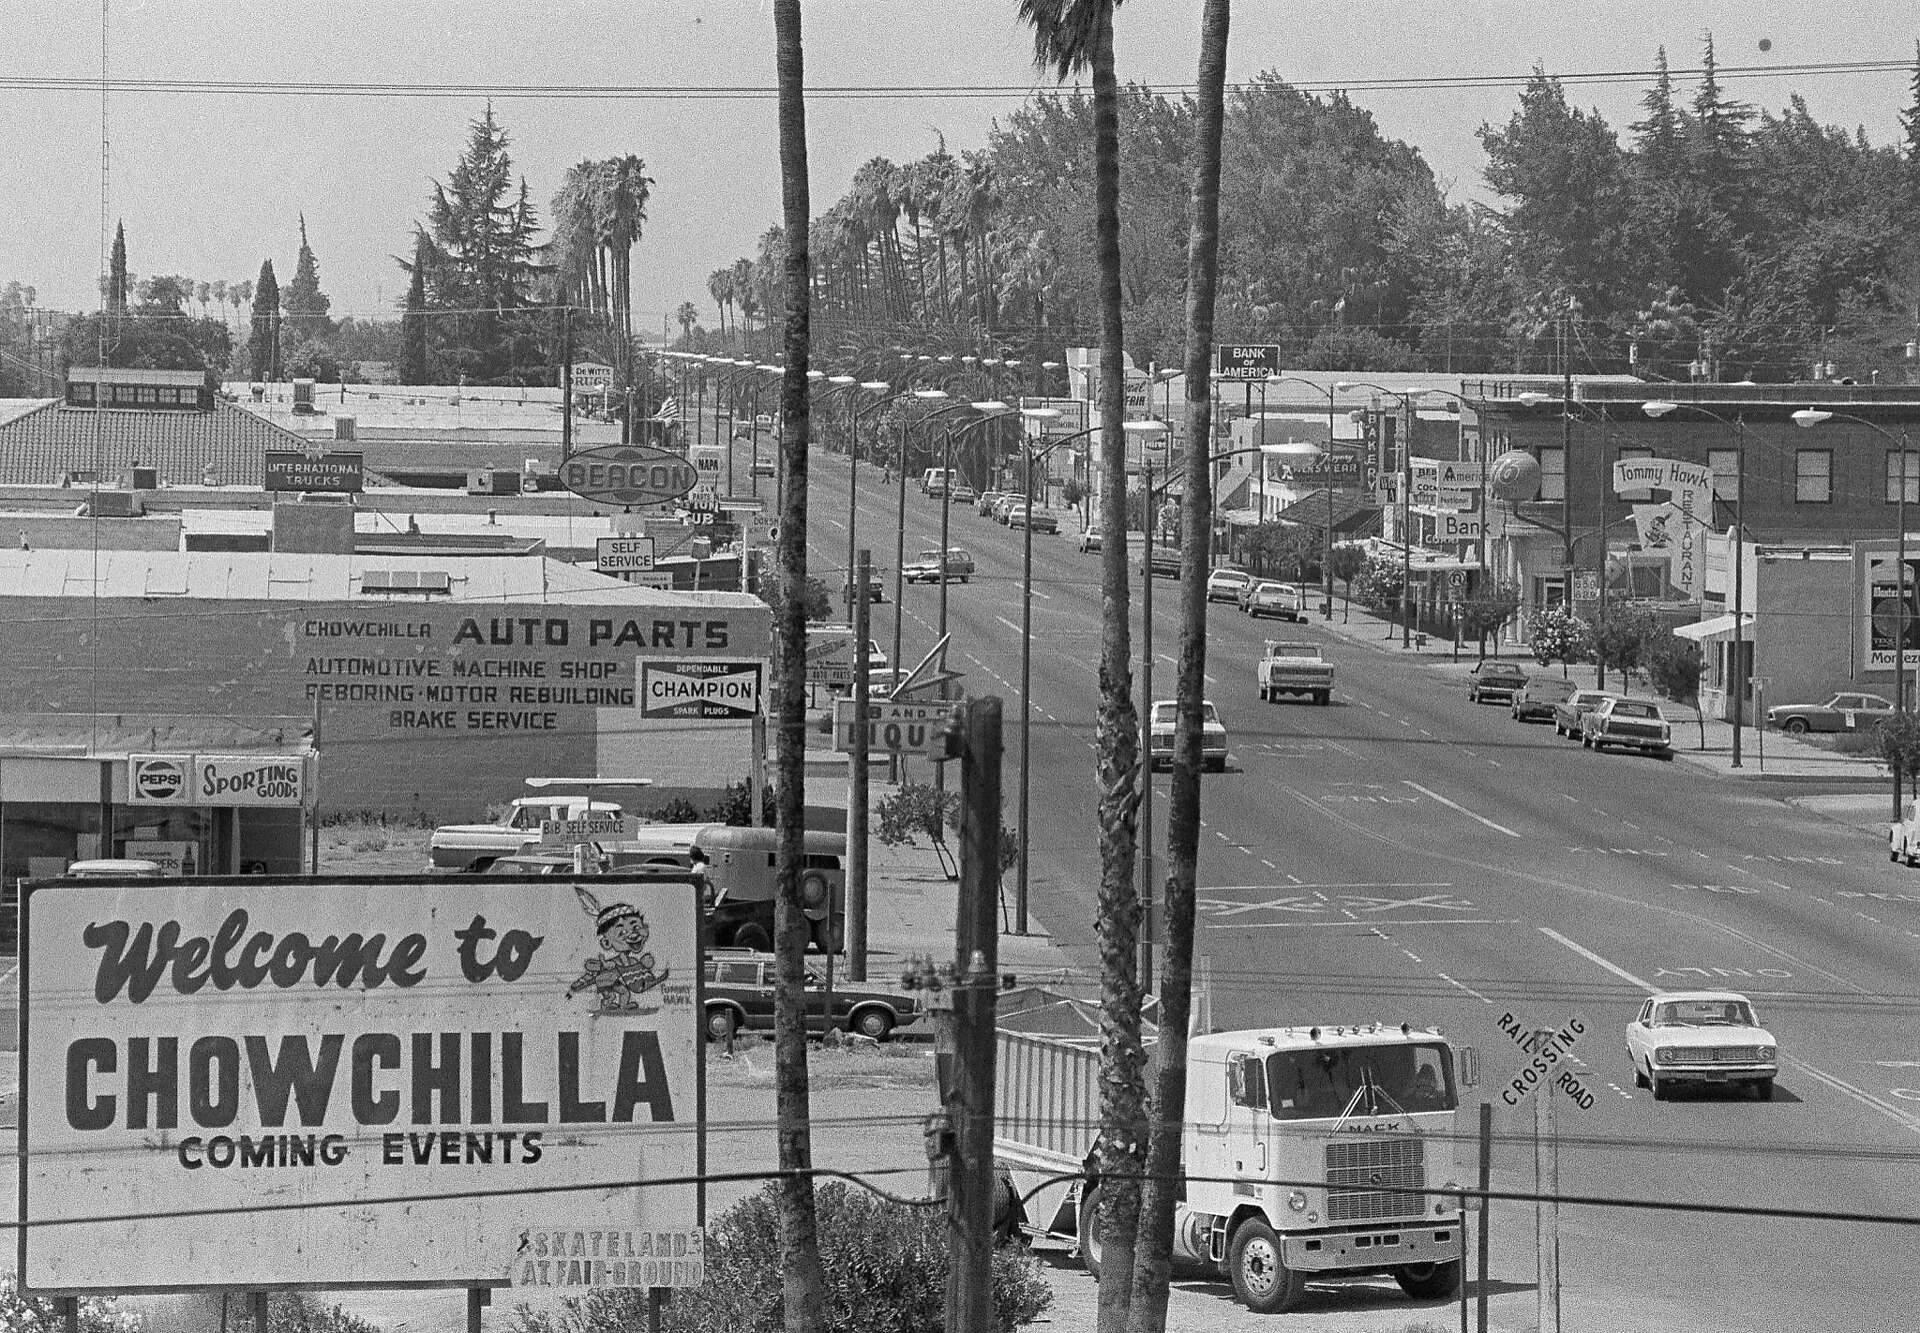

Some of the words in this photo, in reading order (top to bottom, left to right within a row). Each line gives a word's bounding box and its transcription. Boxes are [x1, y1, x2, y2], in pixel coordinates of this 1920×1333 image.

[1233, 348, 1266, 358] BANK
[1223, 367, 1274, 377] AMERICA
[1367, 413, 1378, 491] BAKERY
[268, 463, 360, 474] INTERNATIONAL
[698, 459, 718, 471] NAPA
[286, 475, 341, 485] TRUCKS
[568, 463, 690, 489] BEACON
[1617, 463, 1663, 486] Tommy
[1670, 463, 1709, 488] Hawk
[1446, 517, 1491, 535] Bank
[611, 542, 641, 553] SELF
[1682, 490, 1694, 591] RESTAURANT
[600, 555, 651, 567] SERVICE
[305, 620, 431, 637] CHOWCHILLA
[453, 617, 569, 646] AUTO
[589, 619, 728, 648] PARTS
[305, 657, 441, 677] AUTOMOTIVE
[452, 660, 546, 678] MACHINE
[560, 661, 617, 679] SHOP
[676, 664, 729, 674] DEPENDABLE
[509, 686, 634, 705] REBUILDING
[652, 681, 751, 698] CHAMPION
[390, 710, 457, 729] BRAKE
[467, 711, 557, 730] SERVICE
[673, 706, 698, 715] SPARK
[704, 707, 729, 715] PLUGS
[891, 708, 926, 718] AND
[139, 774, 181, 785] PEPSI
[203, 764, 298, 797] SPORTING
[257, 781, 298, 798] GOODS
[567, 821, 586, 834] SELF
[589, 820, 624, 833] SERVICE
[83, 908, 427, 1004] Welcome
[454, 915, 545, 982] to
[1497, 1012, 1536, 1054] RAIL
[1556, 1071, 1595, 1110] ROAD
[1502, 1019, 1585, 1105] CROSSING
[65, 1030, 675, 1131] CHOWCHILLA
[1349, 1122, 1400, 1133] MACK
[178, 1133, 348, 1169] COMING
[382, 1131, 544, 1165] EVENTS
[535, 1231, 687, 1257] SKATELAND
[521, 1260, 550, 1287] AT
